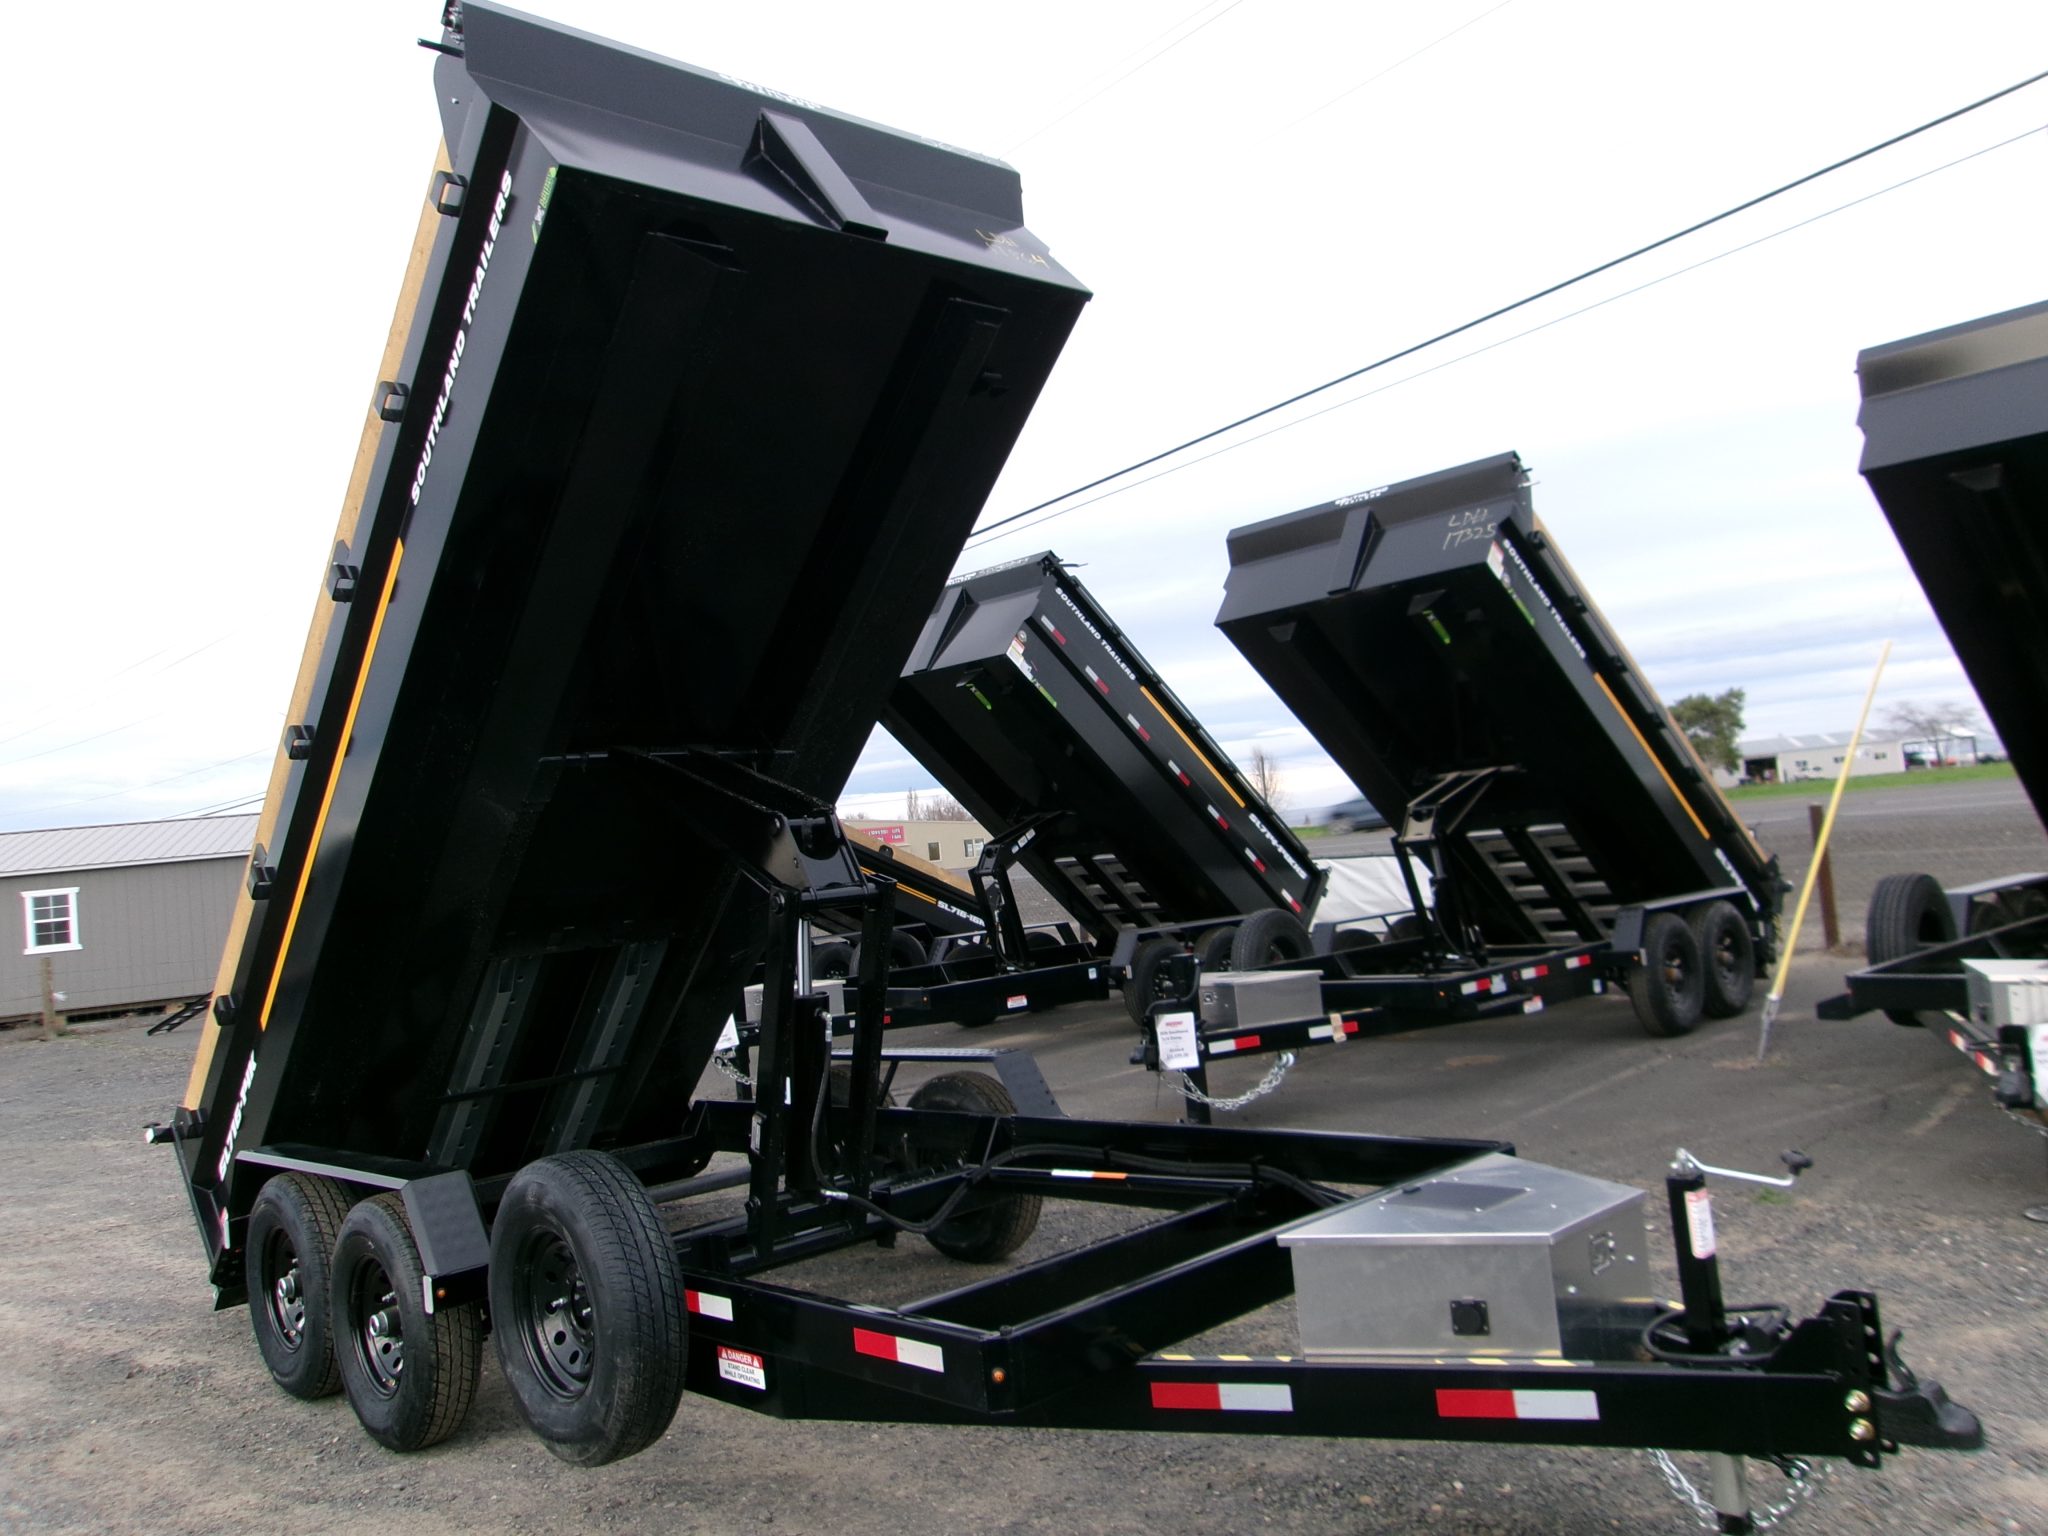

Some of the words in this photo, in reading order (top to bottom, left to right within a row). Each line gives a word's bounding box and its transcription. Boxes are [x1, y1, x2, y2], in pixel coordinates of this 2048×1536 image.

[411, 331, 465, 505] SOUTHLAND
[463, 170, 513, 324] TRAILERS
[1443, 522, 1498, 551] 17325
[1503, 539, 1551, 607] SOUTHLAND
[1550, 607, 1587, 659] TRAILERS
[1055, 587, 1101, 641] SOUTHLAND
[1099, 636, 1138, 681] TRAILERS
[727, 1349, 753, 1365] DANGER
[727, 1362, 741, 1371] STAND
[741, 1365, 755, 1374] CLEAR
[724, 1369, 737, 1378] WHILE
[737, 1372, 761, 1384] OPERATING
